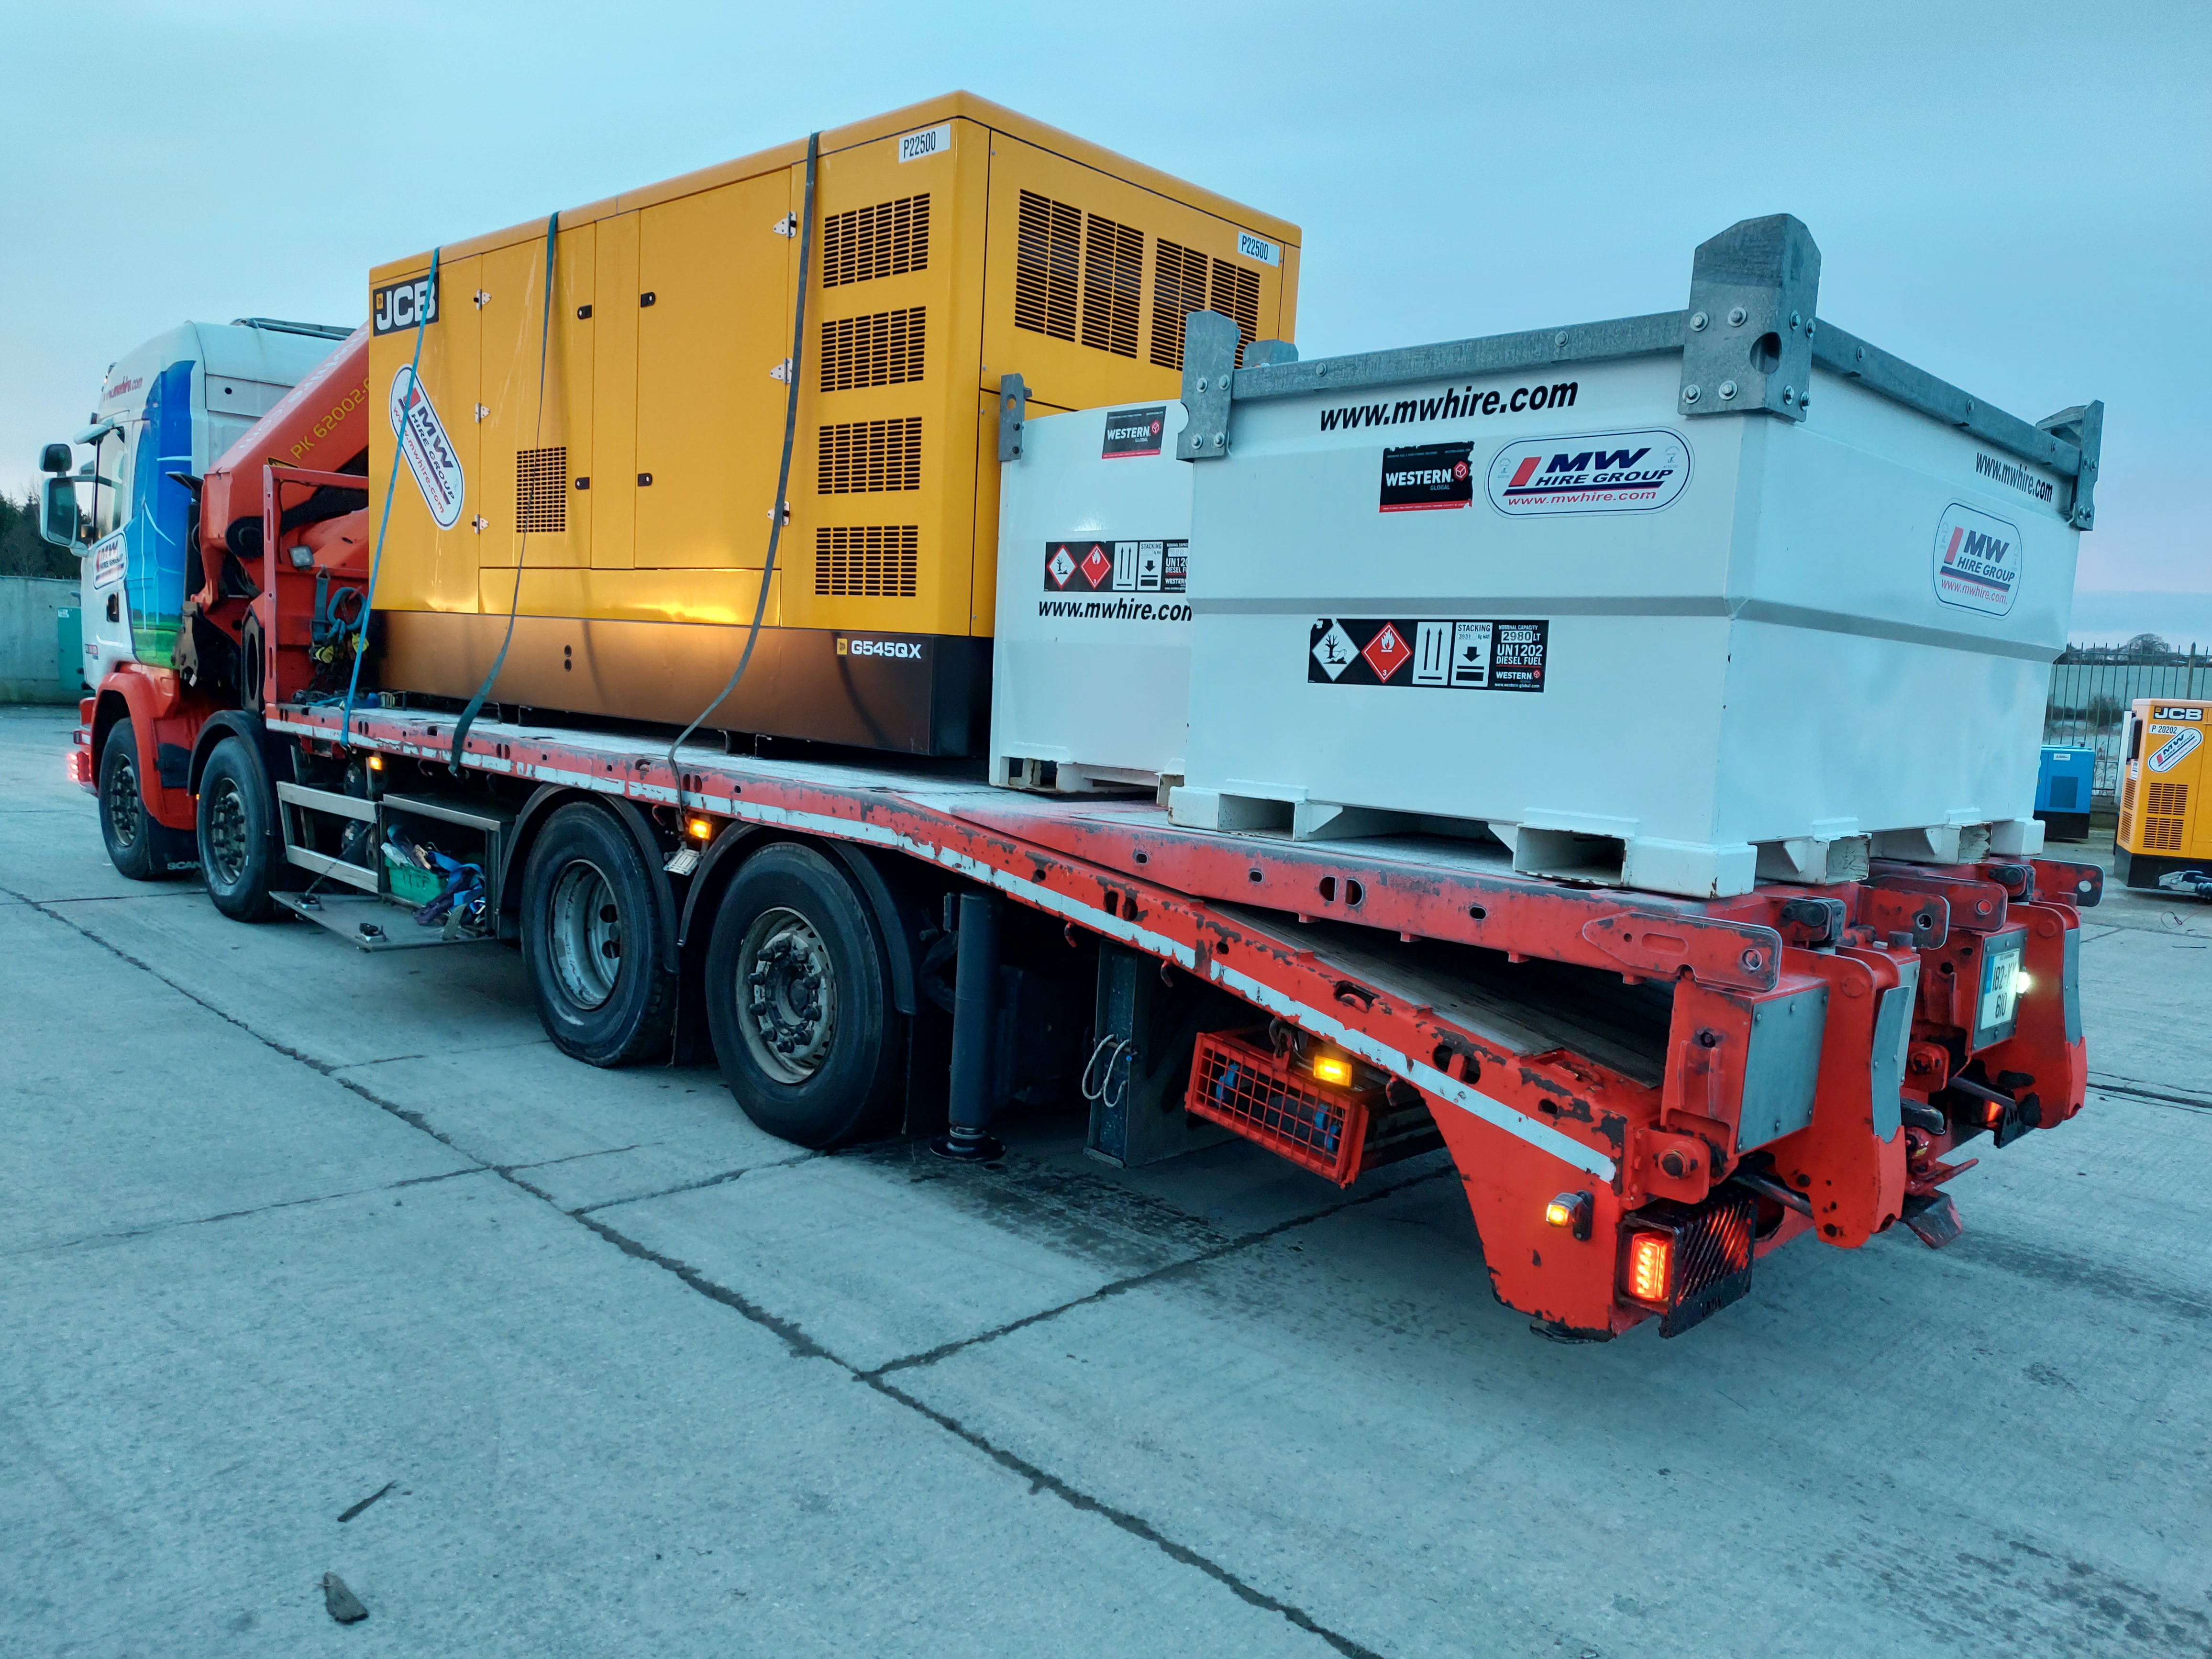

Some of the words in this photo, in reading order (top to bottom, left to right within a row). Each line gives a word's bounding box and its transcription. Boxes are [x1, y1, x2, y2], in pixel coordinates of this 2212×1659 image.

[903, 131, 936, 159] P22500
[1241, 234, 1269, 260] P22500
[376, 280, 436, 331] JCB
[1320, 381, 1579, 431] www.mwhire.com
[290, 435, 316, 460] PK
[417, 406, 454, 468] MW
[411, 413, 430, 447] HIRE
[429, 450, 455, 500] GROUP
[1545, 447, 1653, 473] MW
[1535, 474, 1590, 487] HIRE
[1592, 469, 1674, 483] GROUP
[1976, 452, 2053, 503] www.mwhire.com
[1508, 490, 1657, 506] www.mwhire.com
[1963, 529, 2010, 564] MW
[1957, 556, 1983, 574] HIRE
[1982, 564, 2015, 583] GROUP
[1941, 579, 2007, 605] www.mwhire.com
[1503, 631, 1532, 641] 2980
[1533, 633, 1541, 641] LT
[851, 640, 922, 659] G545QX
[1496, 644, 1543, 657] UN1202
[1496, 656, 1522, 665] DIESEL
[1524, 656, 1542, 665] FUEL
[2155, 708, 2202, 720] JCB
[2158, 725, 2178, 734] 20202
[2163, 733, 2184, 756] MW
[1995, 992, 2008, 1018] 610
